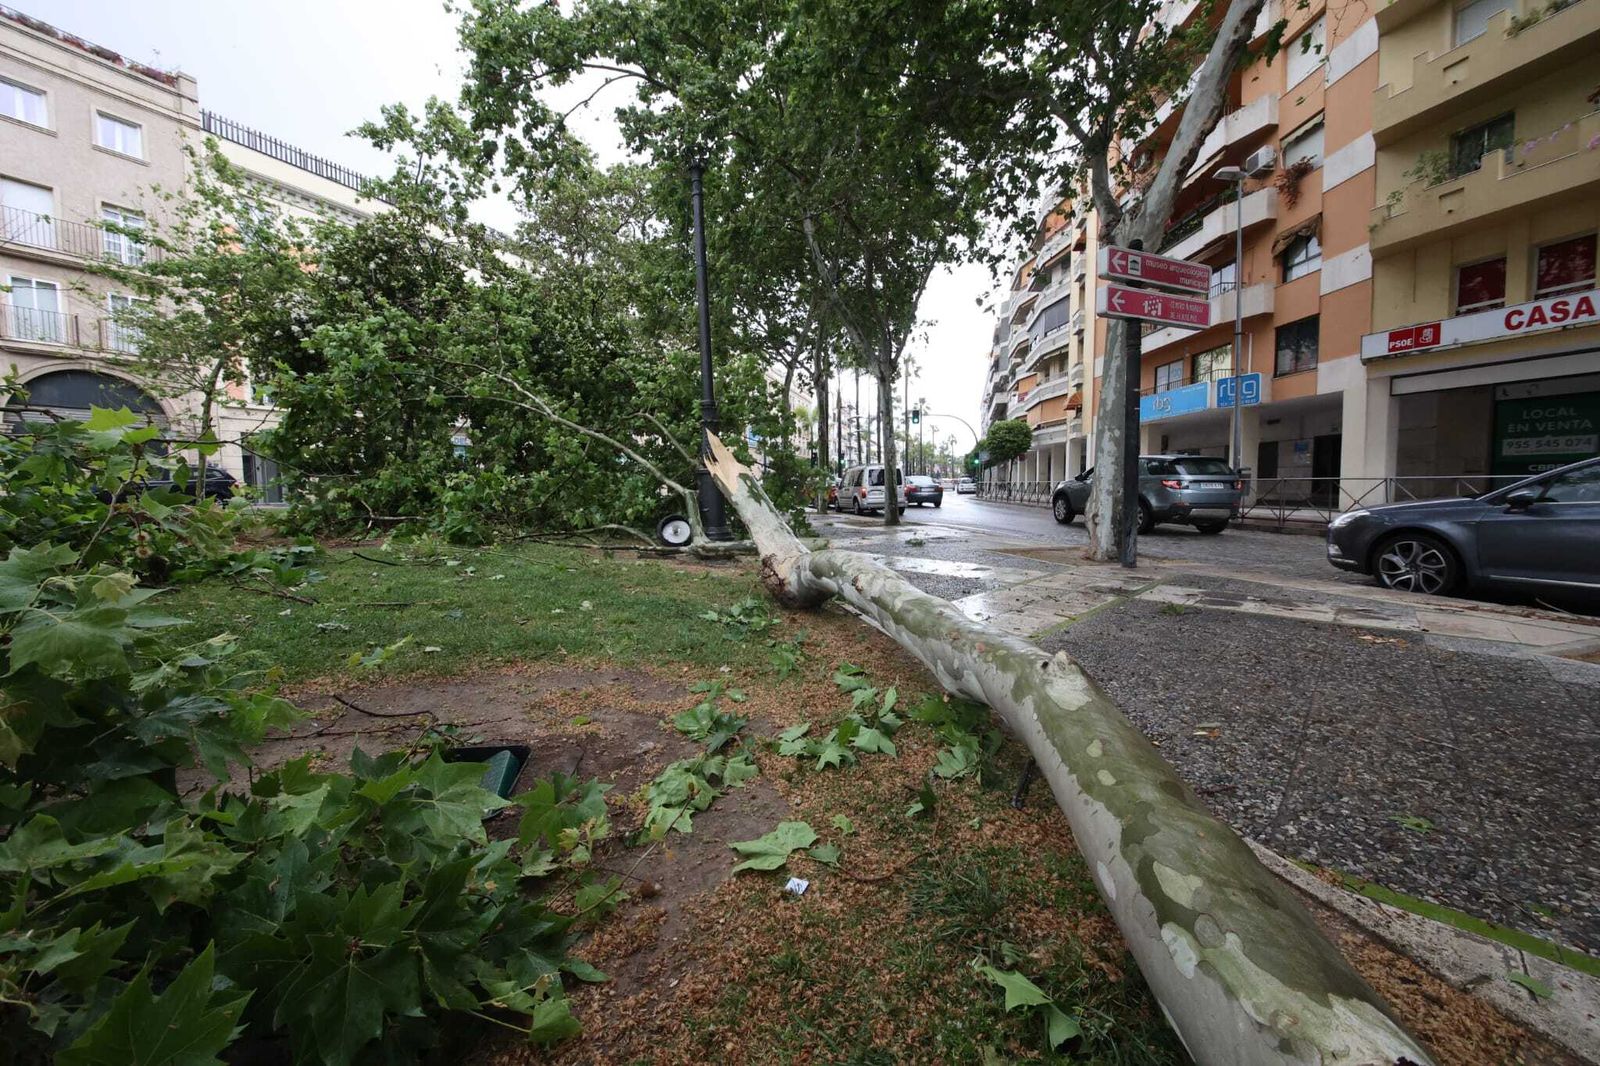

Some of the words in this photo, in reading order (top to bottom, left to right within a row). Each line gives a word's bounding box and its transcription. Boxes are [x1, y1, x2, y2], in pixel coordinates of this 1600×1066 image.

[1145, 260, 1168, 270] museo
[1179, 277, 1208, 289] municipal
[1504, 295, 1596, 331] CASA
[1389, 338, 1413, 349] PSOE
[1522, 407, 1577, 420] LOCAL
[1507, 423, 1529, 433] EN
[1535, 419, 1592, 432] VENTA
[1506, 440, 1530, 449] 955
[1535, 439, 1559, 448] 545
[1564, 437, 1592, 447] 074
